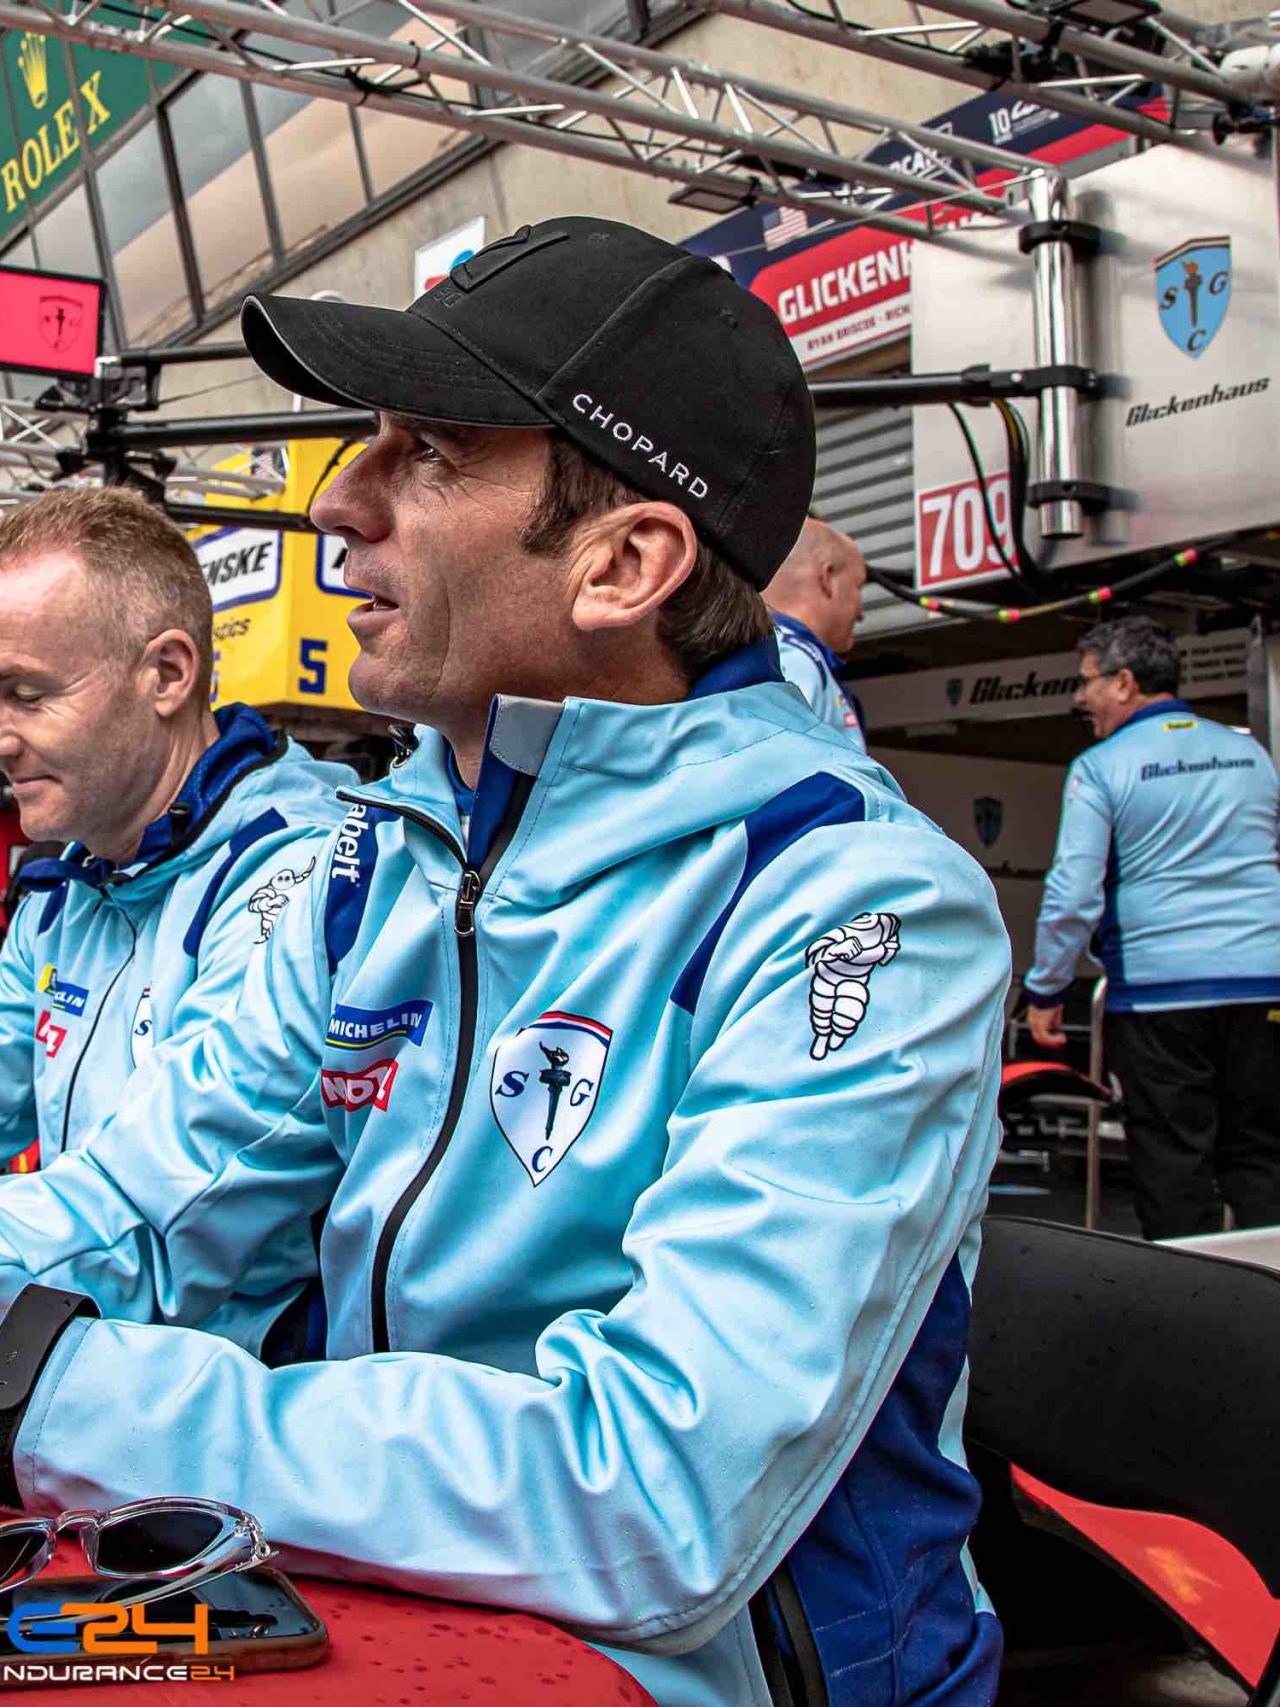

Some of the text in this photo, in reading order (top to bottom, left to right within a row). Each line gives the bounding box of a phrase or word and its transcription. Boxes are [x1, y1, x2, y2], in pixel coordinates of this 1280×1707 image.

[1, 70, 111, 214] ROLEX
[1125, 377, 1271, 427] Glickenhaus
[572, 393, 708, 499] CHOPARD
[922, 478, 1015, 577] 709
[204, 541, 272, 586] NSKE
[298, 638, 327, 694] 5
[969, 671, 1080, 704] Glicken
[331, 803, 369, 883] abelt
[328, 1012, 423, 1039] MICHELIN
[495, 1070, 595, 1107] S G
[531, 1145, 553, 1173] C
